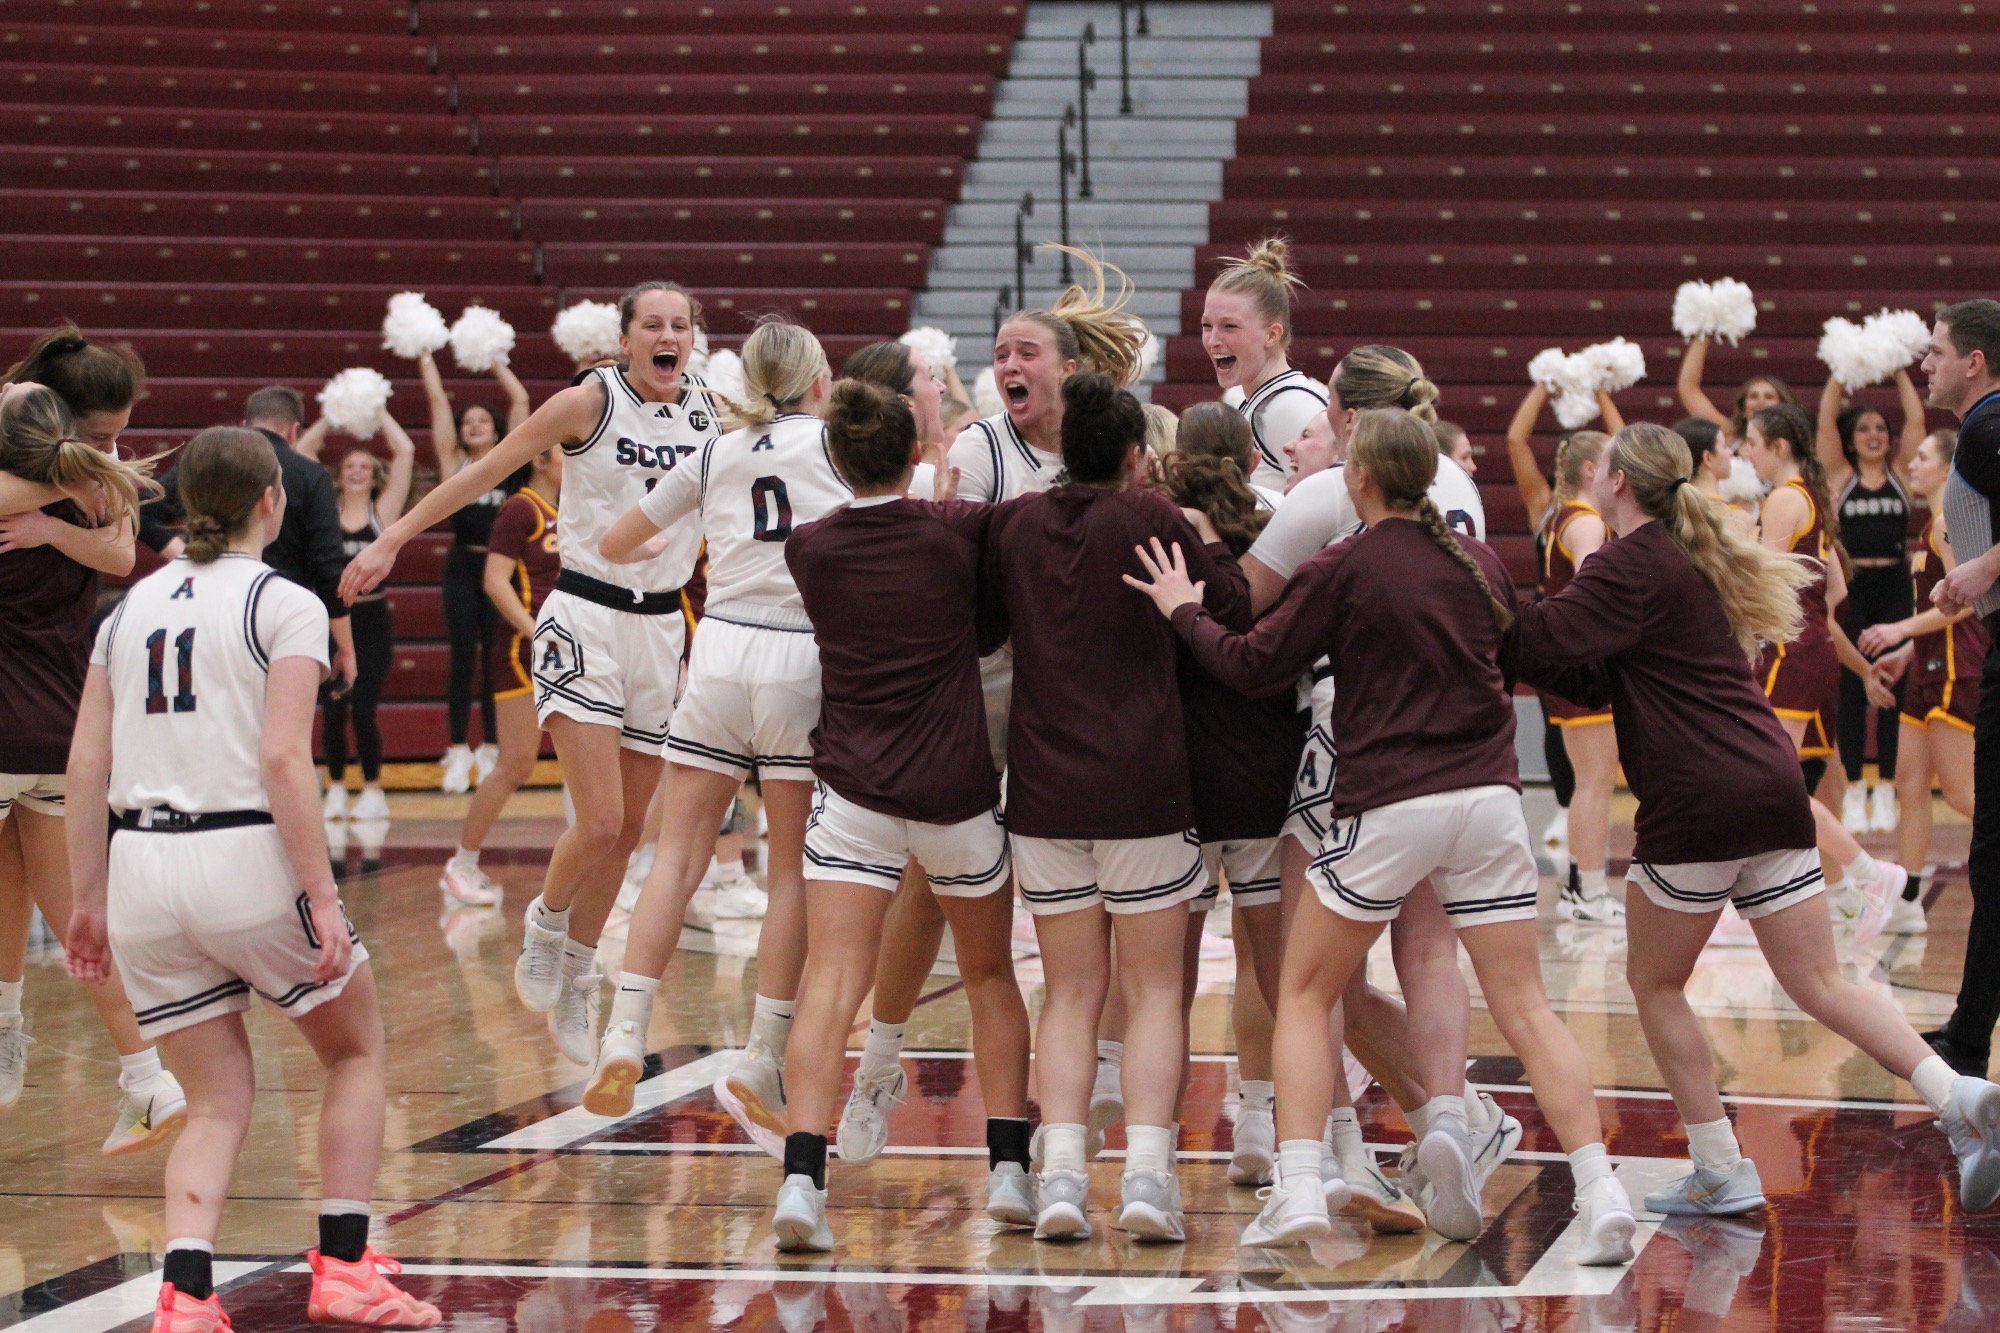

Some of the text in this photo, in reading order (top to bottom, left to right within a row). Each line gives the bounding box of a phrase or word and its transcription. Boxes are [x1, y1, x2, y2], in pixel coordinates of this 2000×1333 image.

[751, 434, 775, 453] A
[751, 475, 792, 542] 0
[170, 577, 195, 600] A
[146, 627, 196, 714] 11
[540, 641, 566, 671] A
[1299, 749, 1319, 789] A
